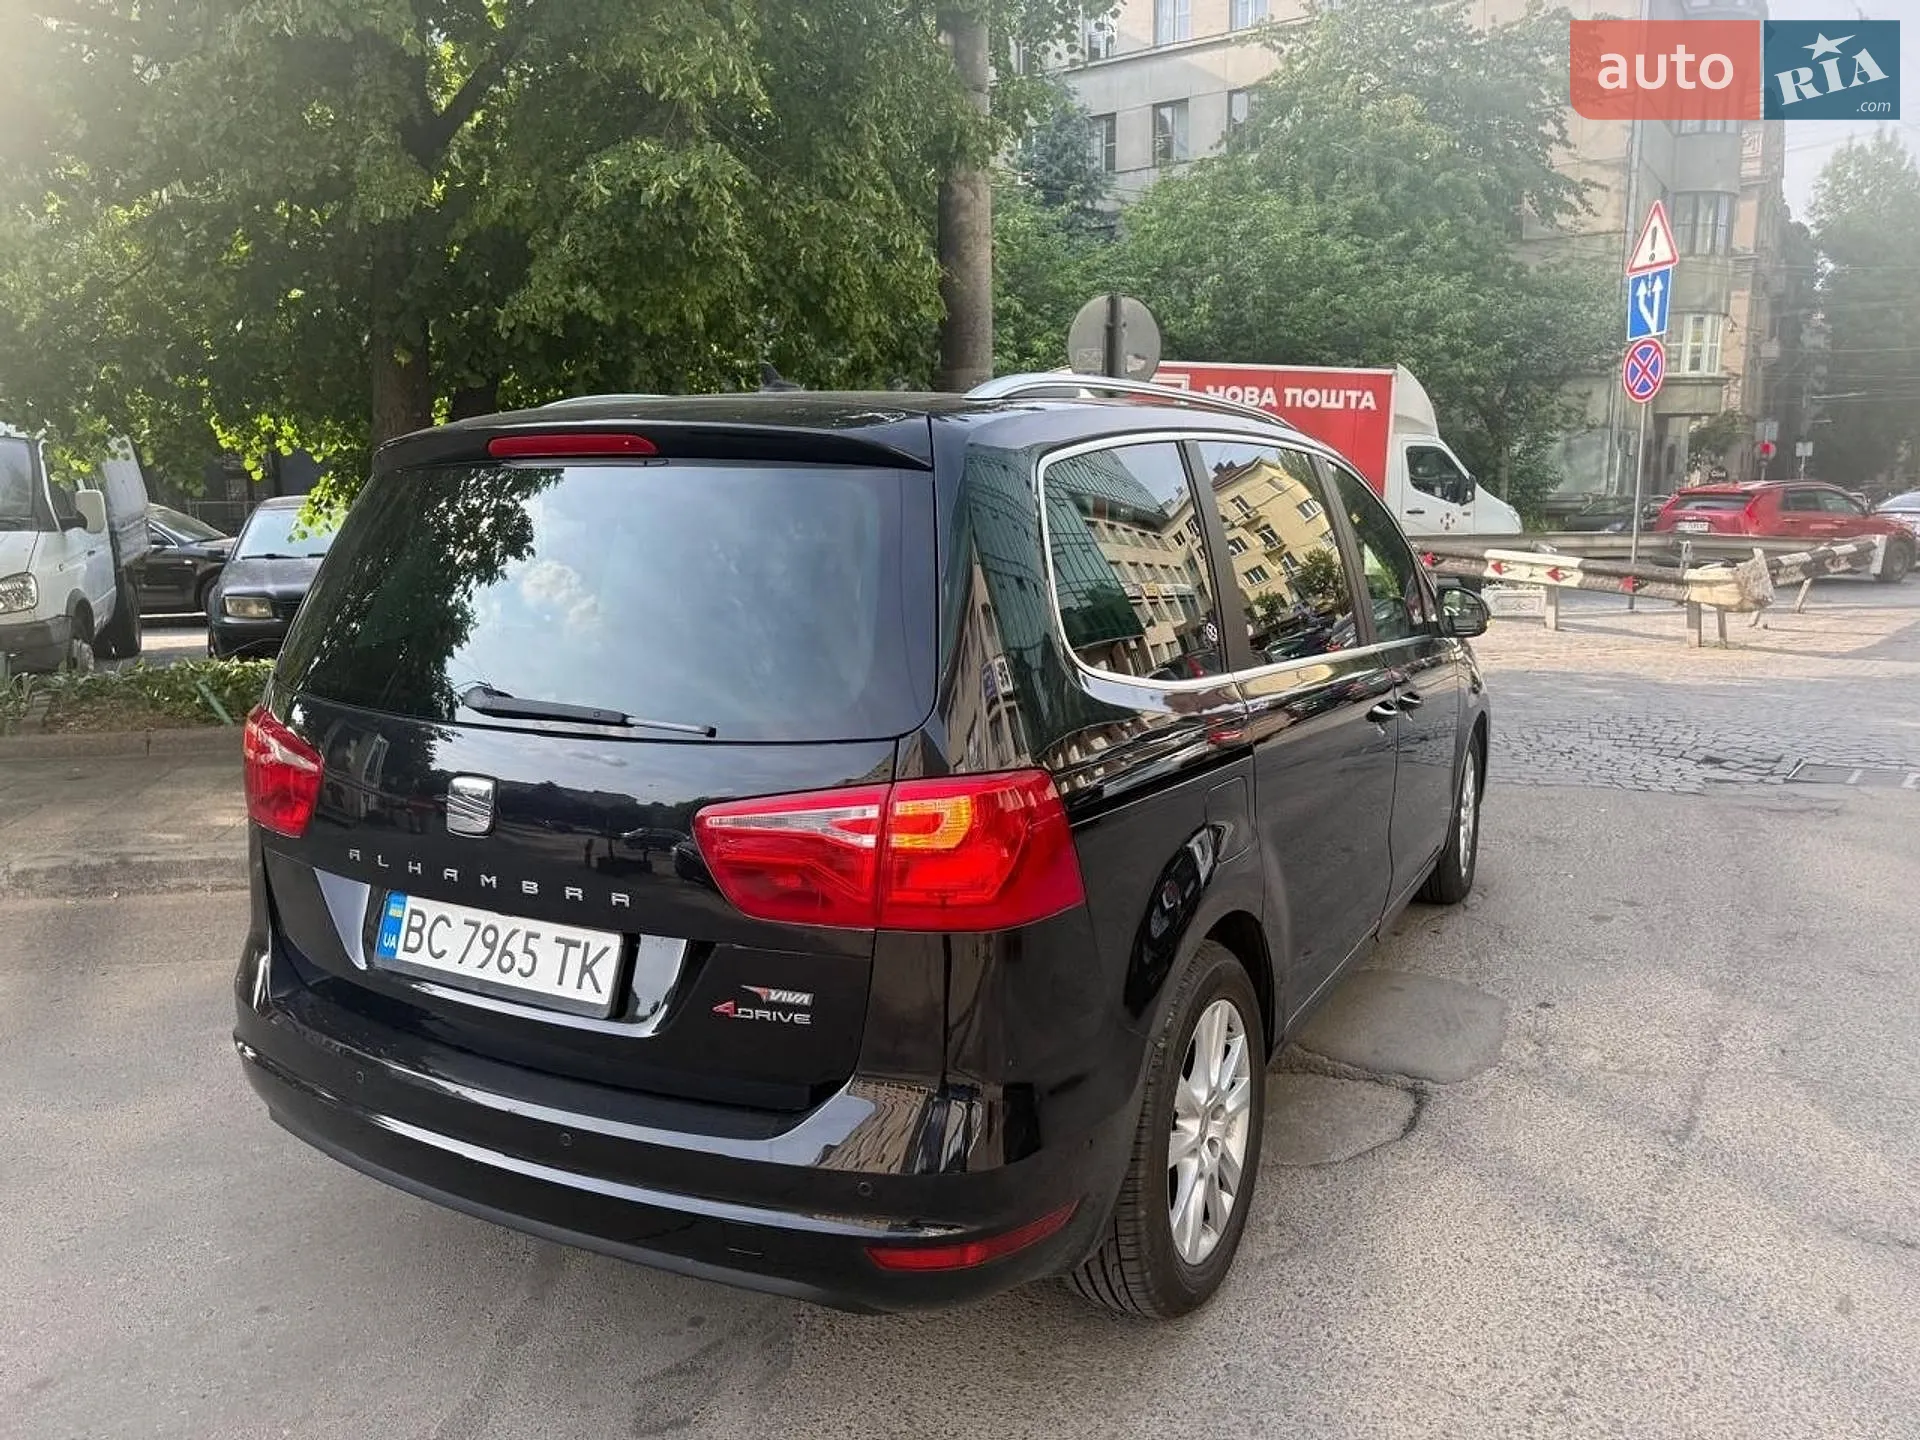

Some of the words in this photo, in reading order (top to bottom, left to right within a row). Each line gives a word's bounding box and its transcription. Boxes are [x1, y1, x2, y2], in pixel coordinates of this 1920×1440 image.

[1284, 387, 1377, 410] ПОШТА
[349, 848, 630, 908] ALHAMBRA
[383, 933, 396, 949] UA
[402, 908, 452, 960] BC
[457, 919, 542, 978] 7965
[554, 935, 611, 994] TK
